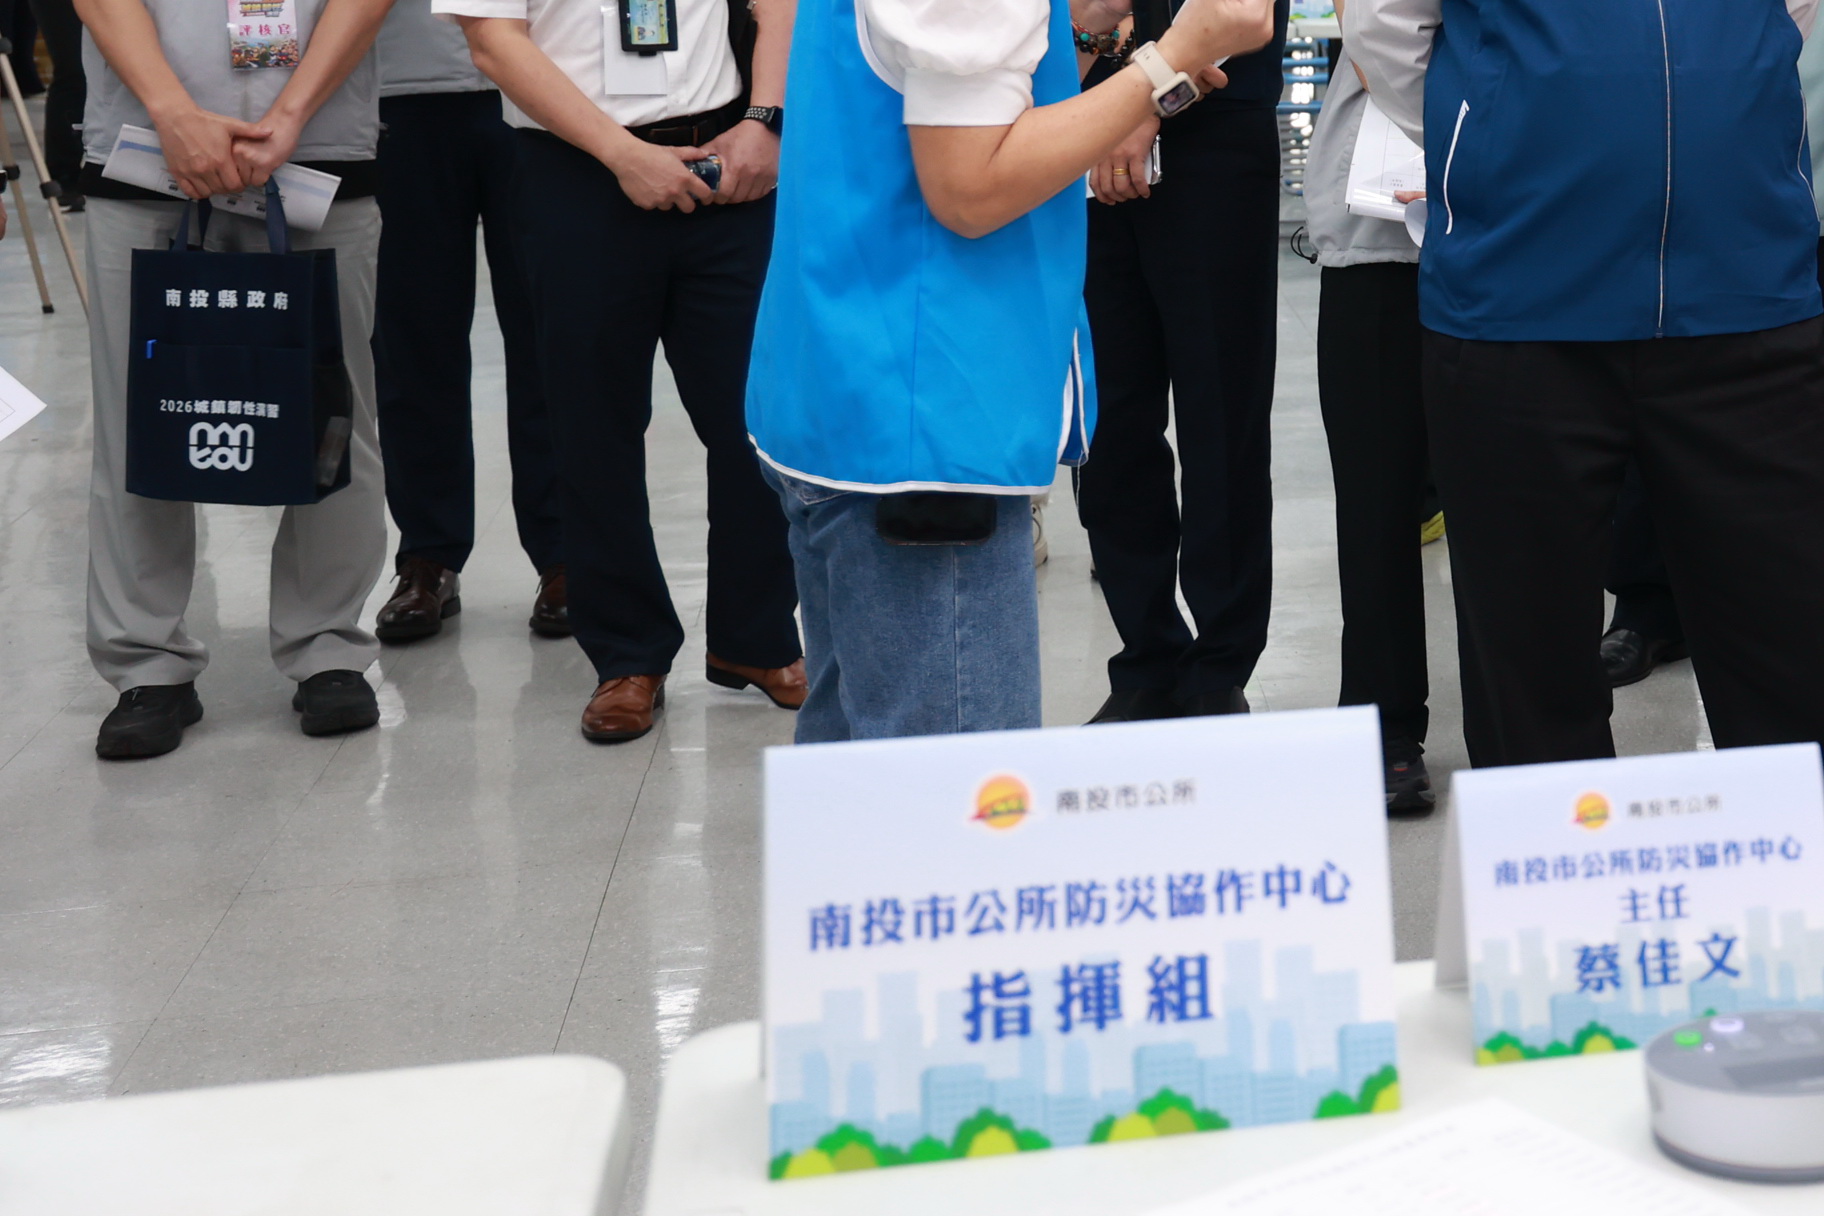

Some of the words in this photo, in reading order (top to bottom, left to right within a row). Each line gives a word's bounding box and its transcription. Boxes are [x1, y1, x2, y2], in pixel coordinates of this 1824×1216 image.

[165, 288, 289, 310] 南投縣政府
[1056, 778, 1198, 815] 南投市公所
[1494, 835, 1803, 887] 南投市公所防災協作中心
[806, 859, 1353, 952] 南投市公所防災協作中心
[1619, 883, 1690, 924] 主任
[1574, 932, 1741, 994] 蔡佳文
[961, 952, 1214, 1044] 指揮組
